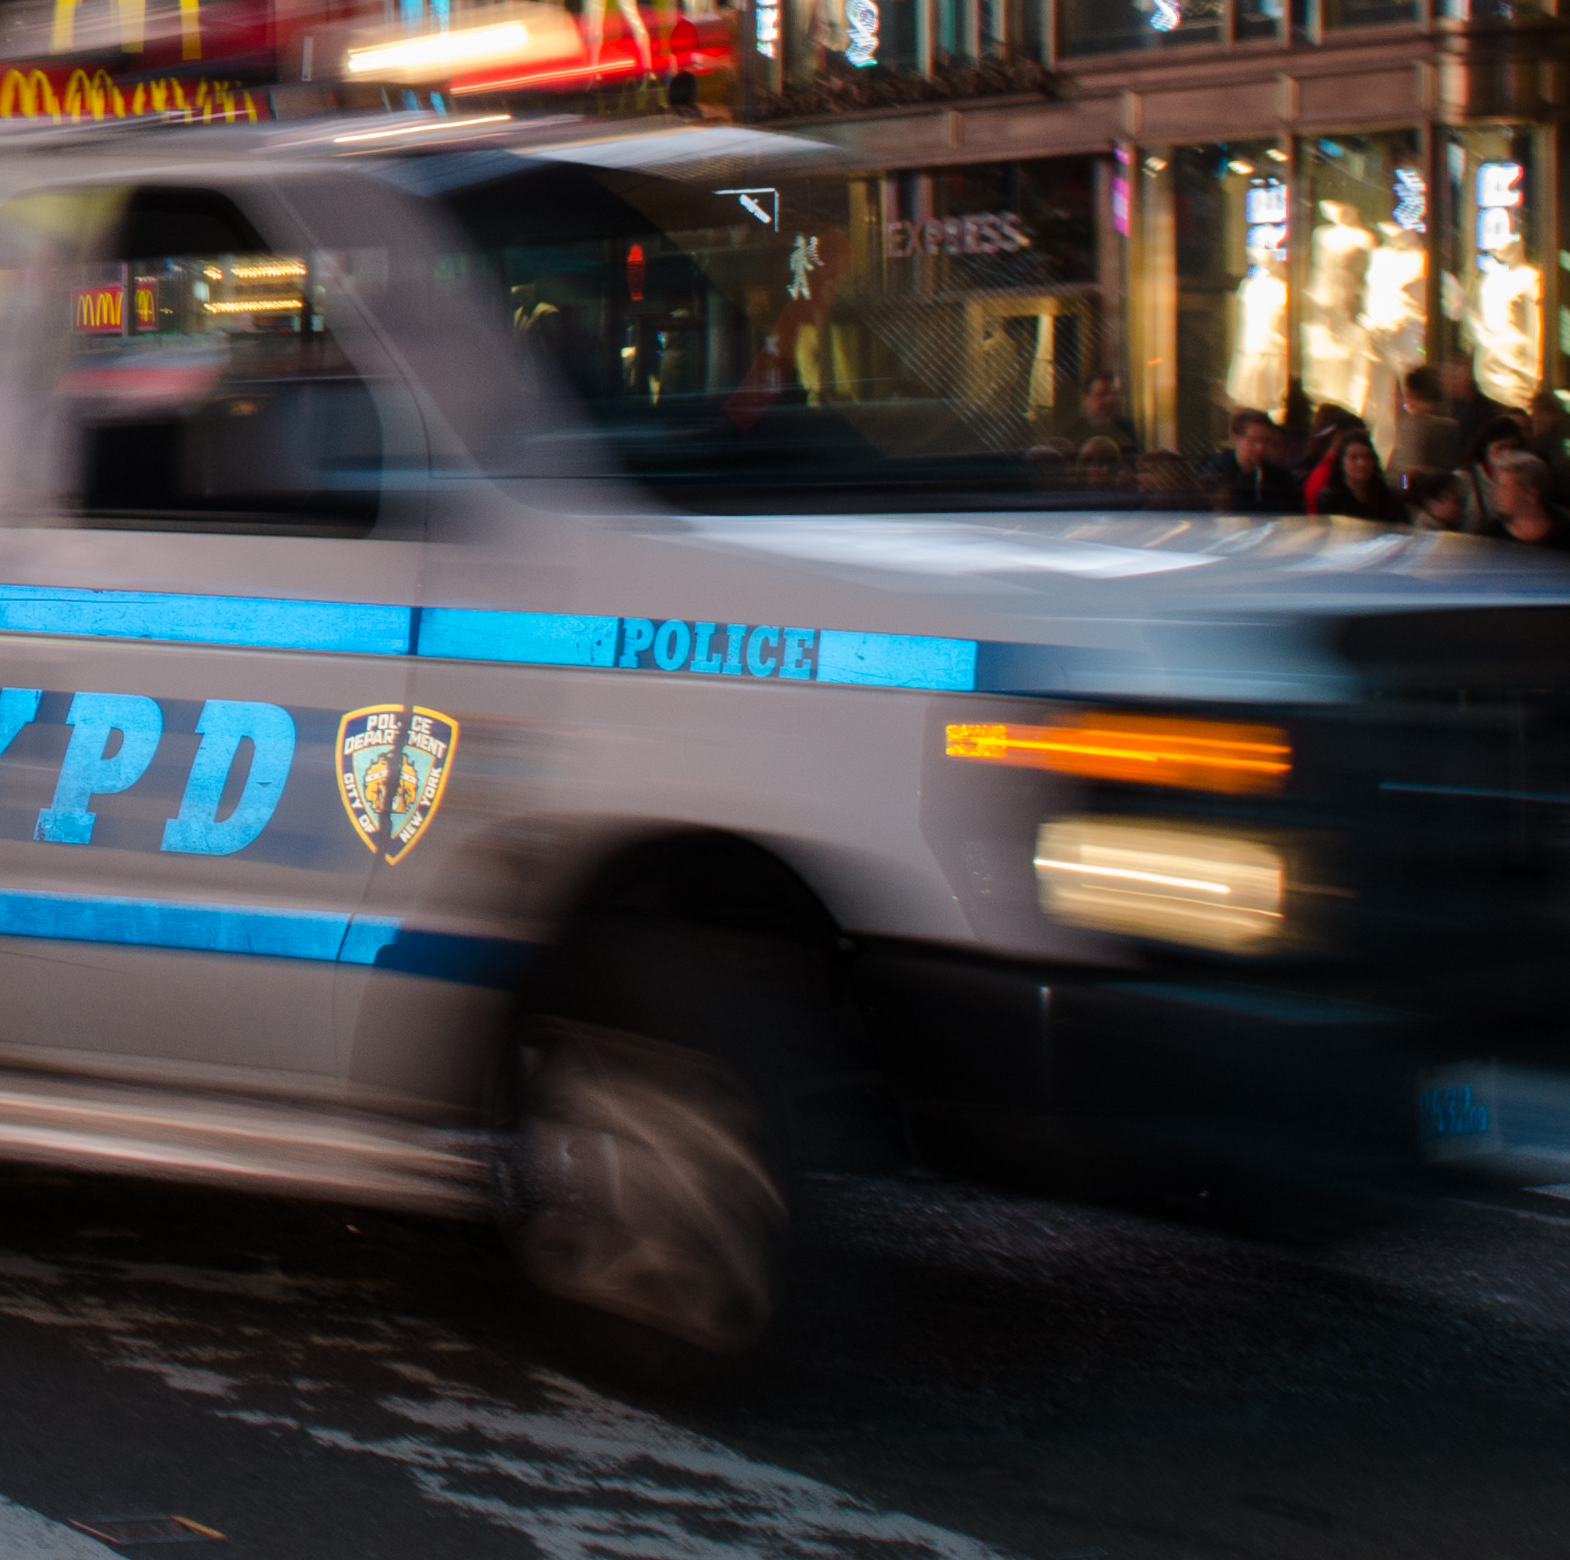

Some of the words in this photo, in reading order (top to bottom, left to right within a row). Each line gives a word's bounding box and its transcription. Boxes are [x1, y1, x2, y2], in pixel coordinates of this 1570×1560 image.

[618, 616, 817, 681] POLICE
[366, 713, 434, 735] POLCE
[343, 772, 364, 809] CITY
[357, 814, 376, 834] OF
[398, 810, 423, 844] NEW
[419, 766, 443, 807] YORK
